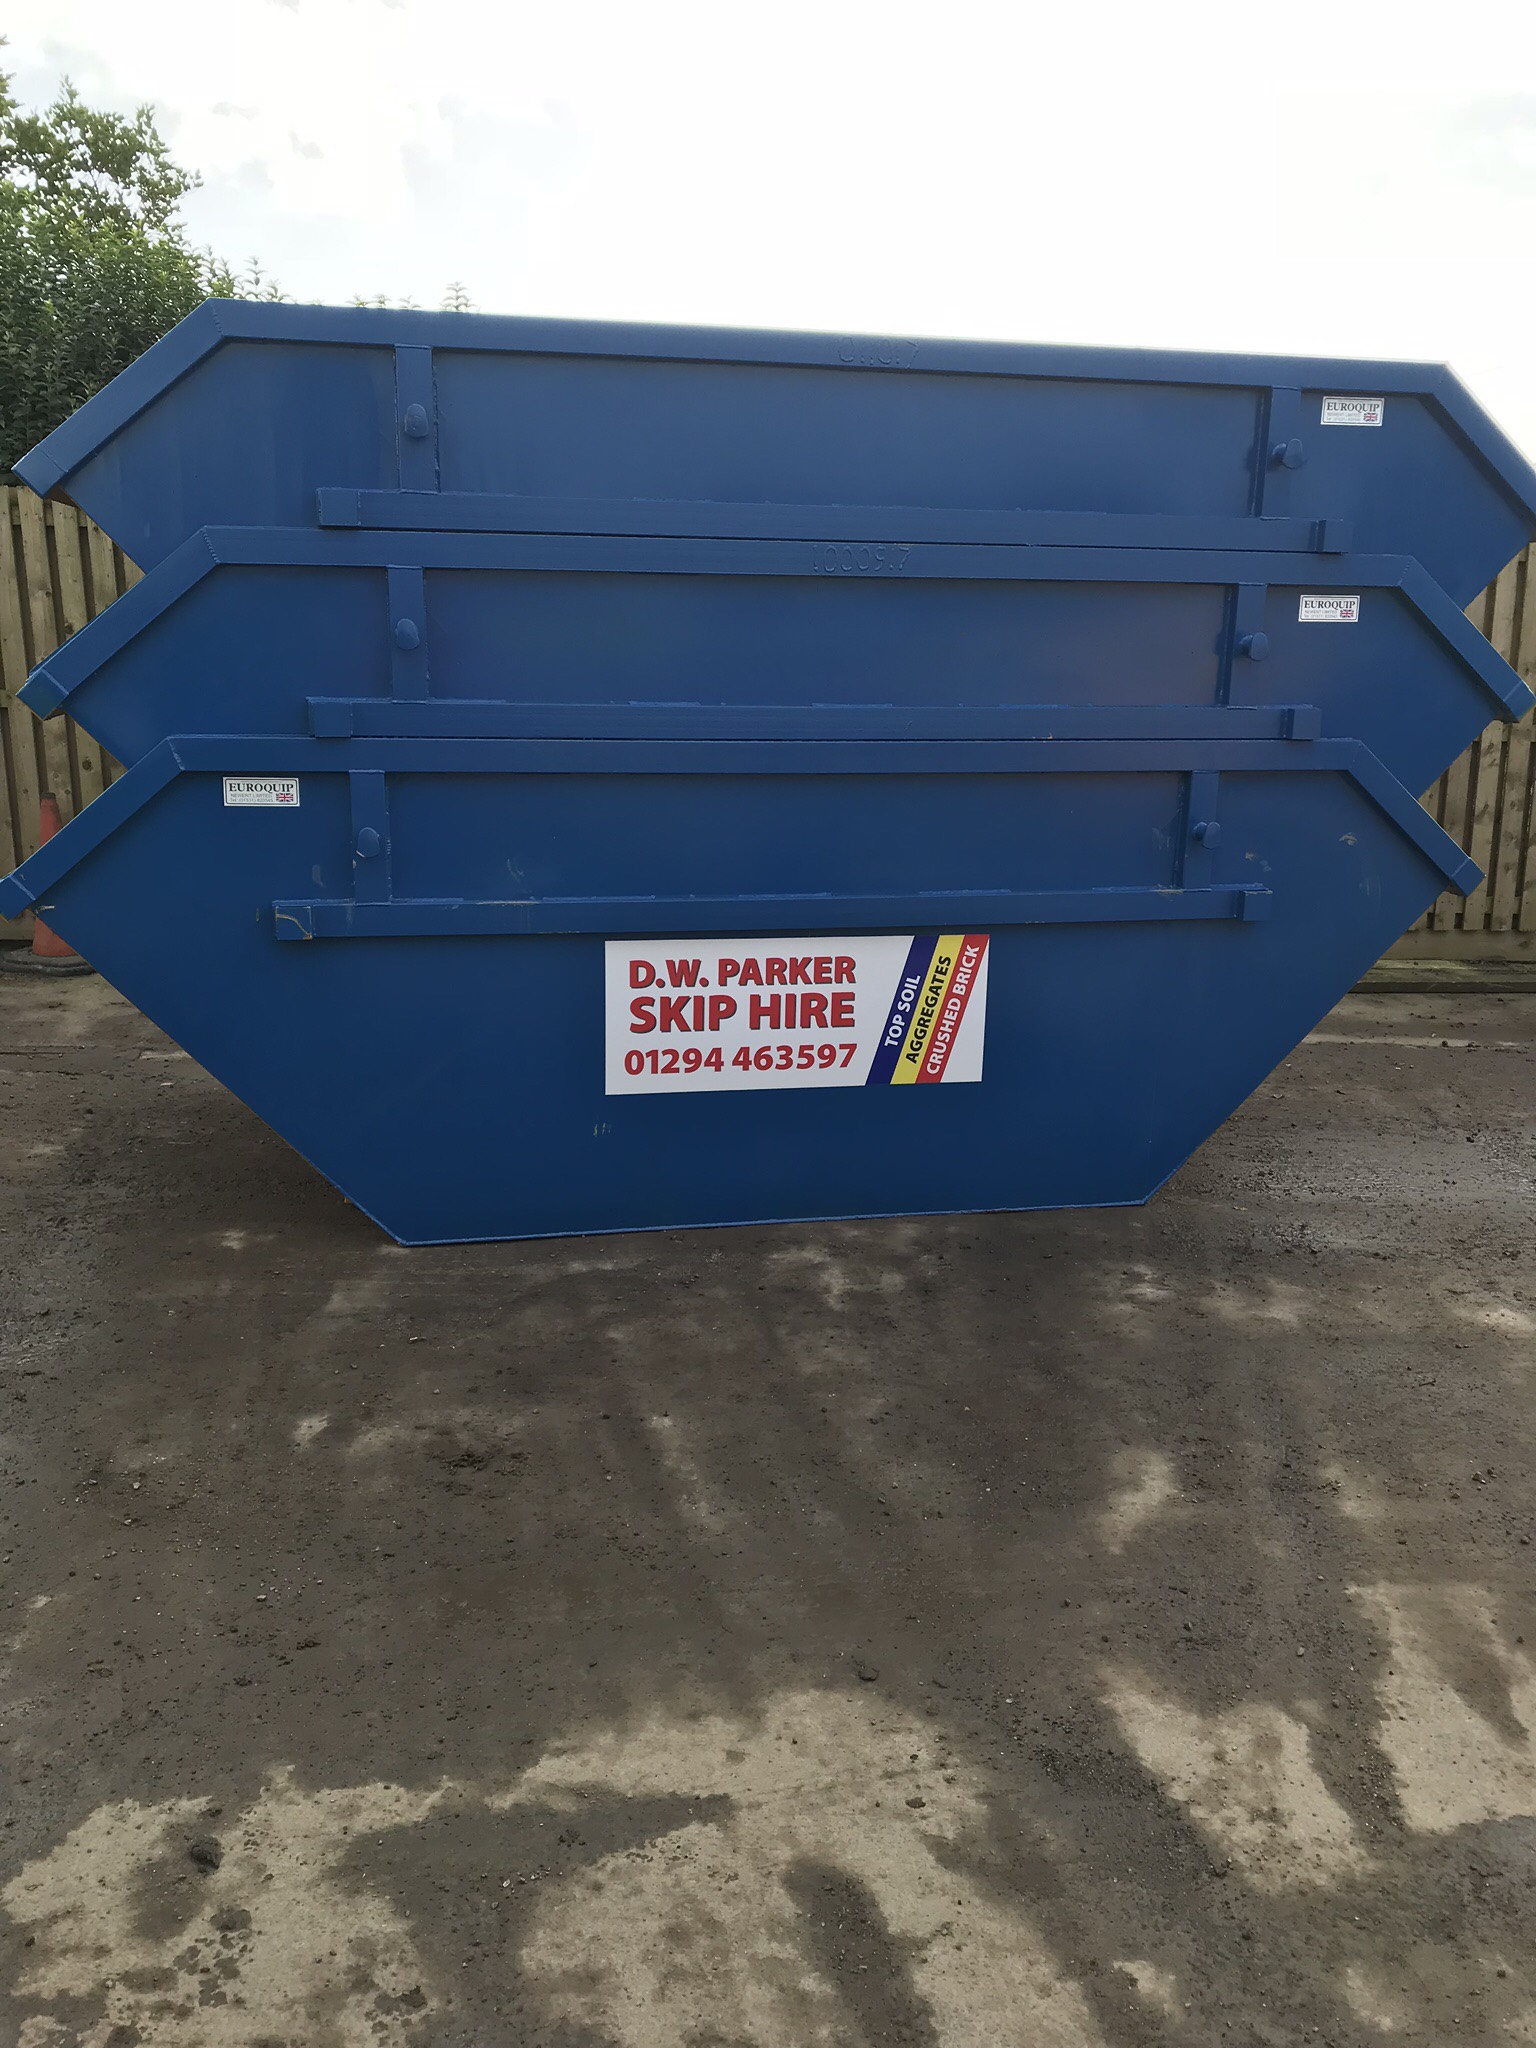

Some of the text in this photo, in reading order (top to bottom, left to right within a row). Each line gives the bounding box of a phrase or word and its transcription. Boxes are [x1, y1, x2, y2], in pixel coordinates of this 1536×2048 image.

[1326, 402, 1380, 413] EUROQUIP
[1304, 600, 1356, 610] EUROQUIP
[229, 783, 294, 793] EUROQUIP
[629, 956, 856, 989] D.W. PARKER
[629, 992, 855, 1034] SKIP HIRE
[884, 975, 920, 1046] TOP SOIL
[905, 955, 951, 1064] AGGREGATES
[926, 944, 980, 1075] CRUSHED BRICK
[624, 1043, 857, 1075] 01294 463597
